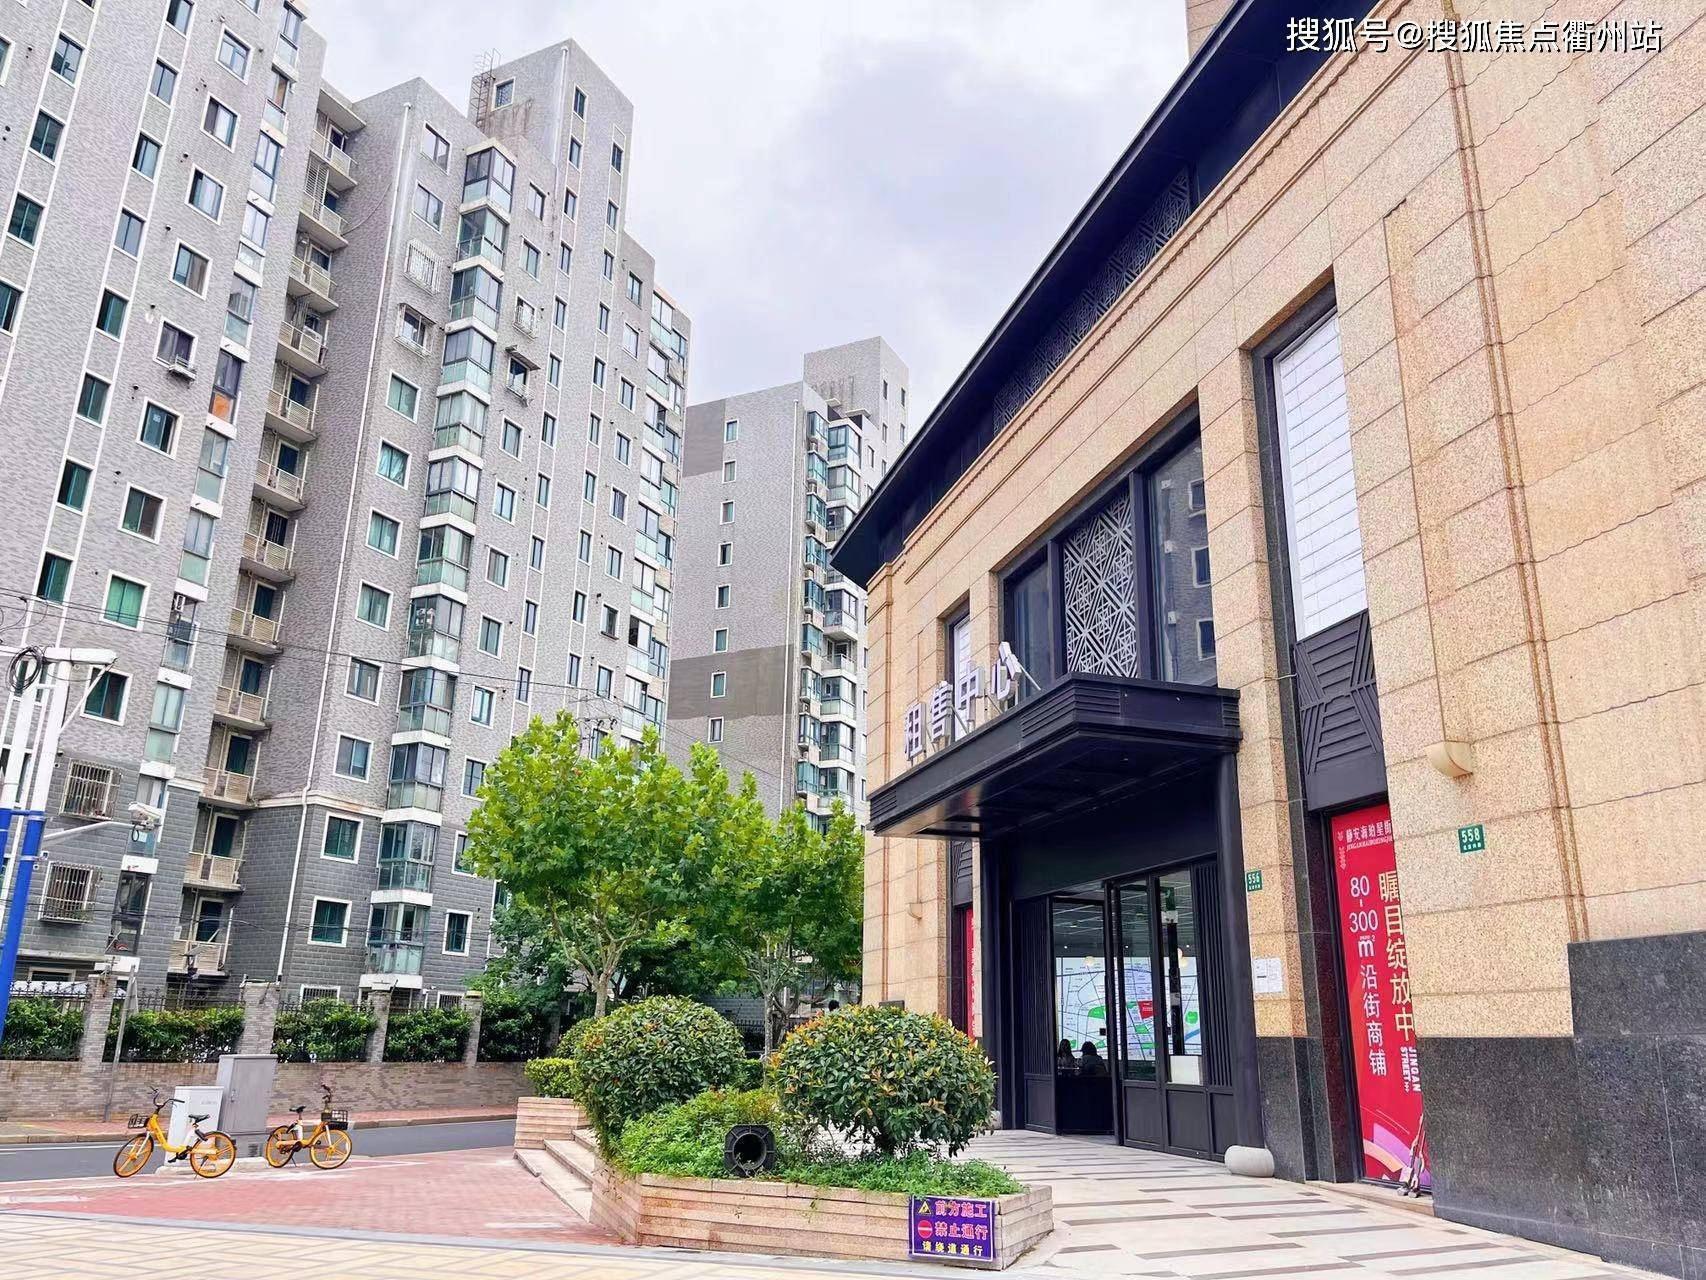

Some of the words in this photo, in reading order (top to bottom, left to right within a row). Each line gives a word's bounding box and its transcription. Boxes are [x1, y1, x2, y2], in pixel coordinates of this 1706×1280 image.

[905, 641, 1022, 761] 租售中心
[1461, 827, 1481, 844] 558
[1350, 875, 1370, 898] 80
[1349, 909, 1379, 933] 300
[1378, 870, 1415, 1042] 瞩目绽放中
[1360, 964, 1387, 1077] 沿街商铺
[1400, 1046, 1412, 1082] STREET
[1408, 1046, 1422, 1092] JINGAN
[934, 1200, 988, 1218] 前方施工
[934, 1220, 989, 1241] 禁止通行
[922, 1240, 983, 1257] 请绕道通行
